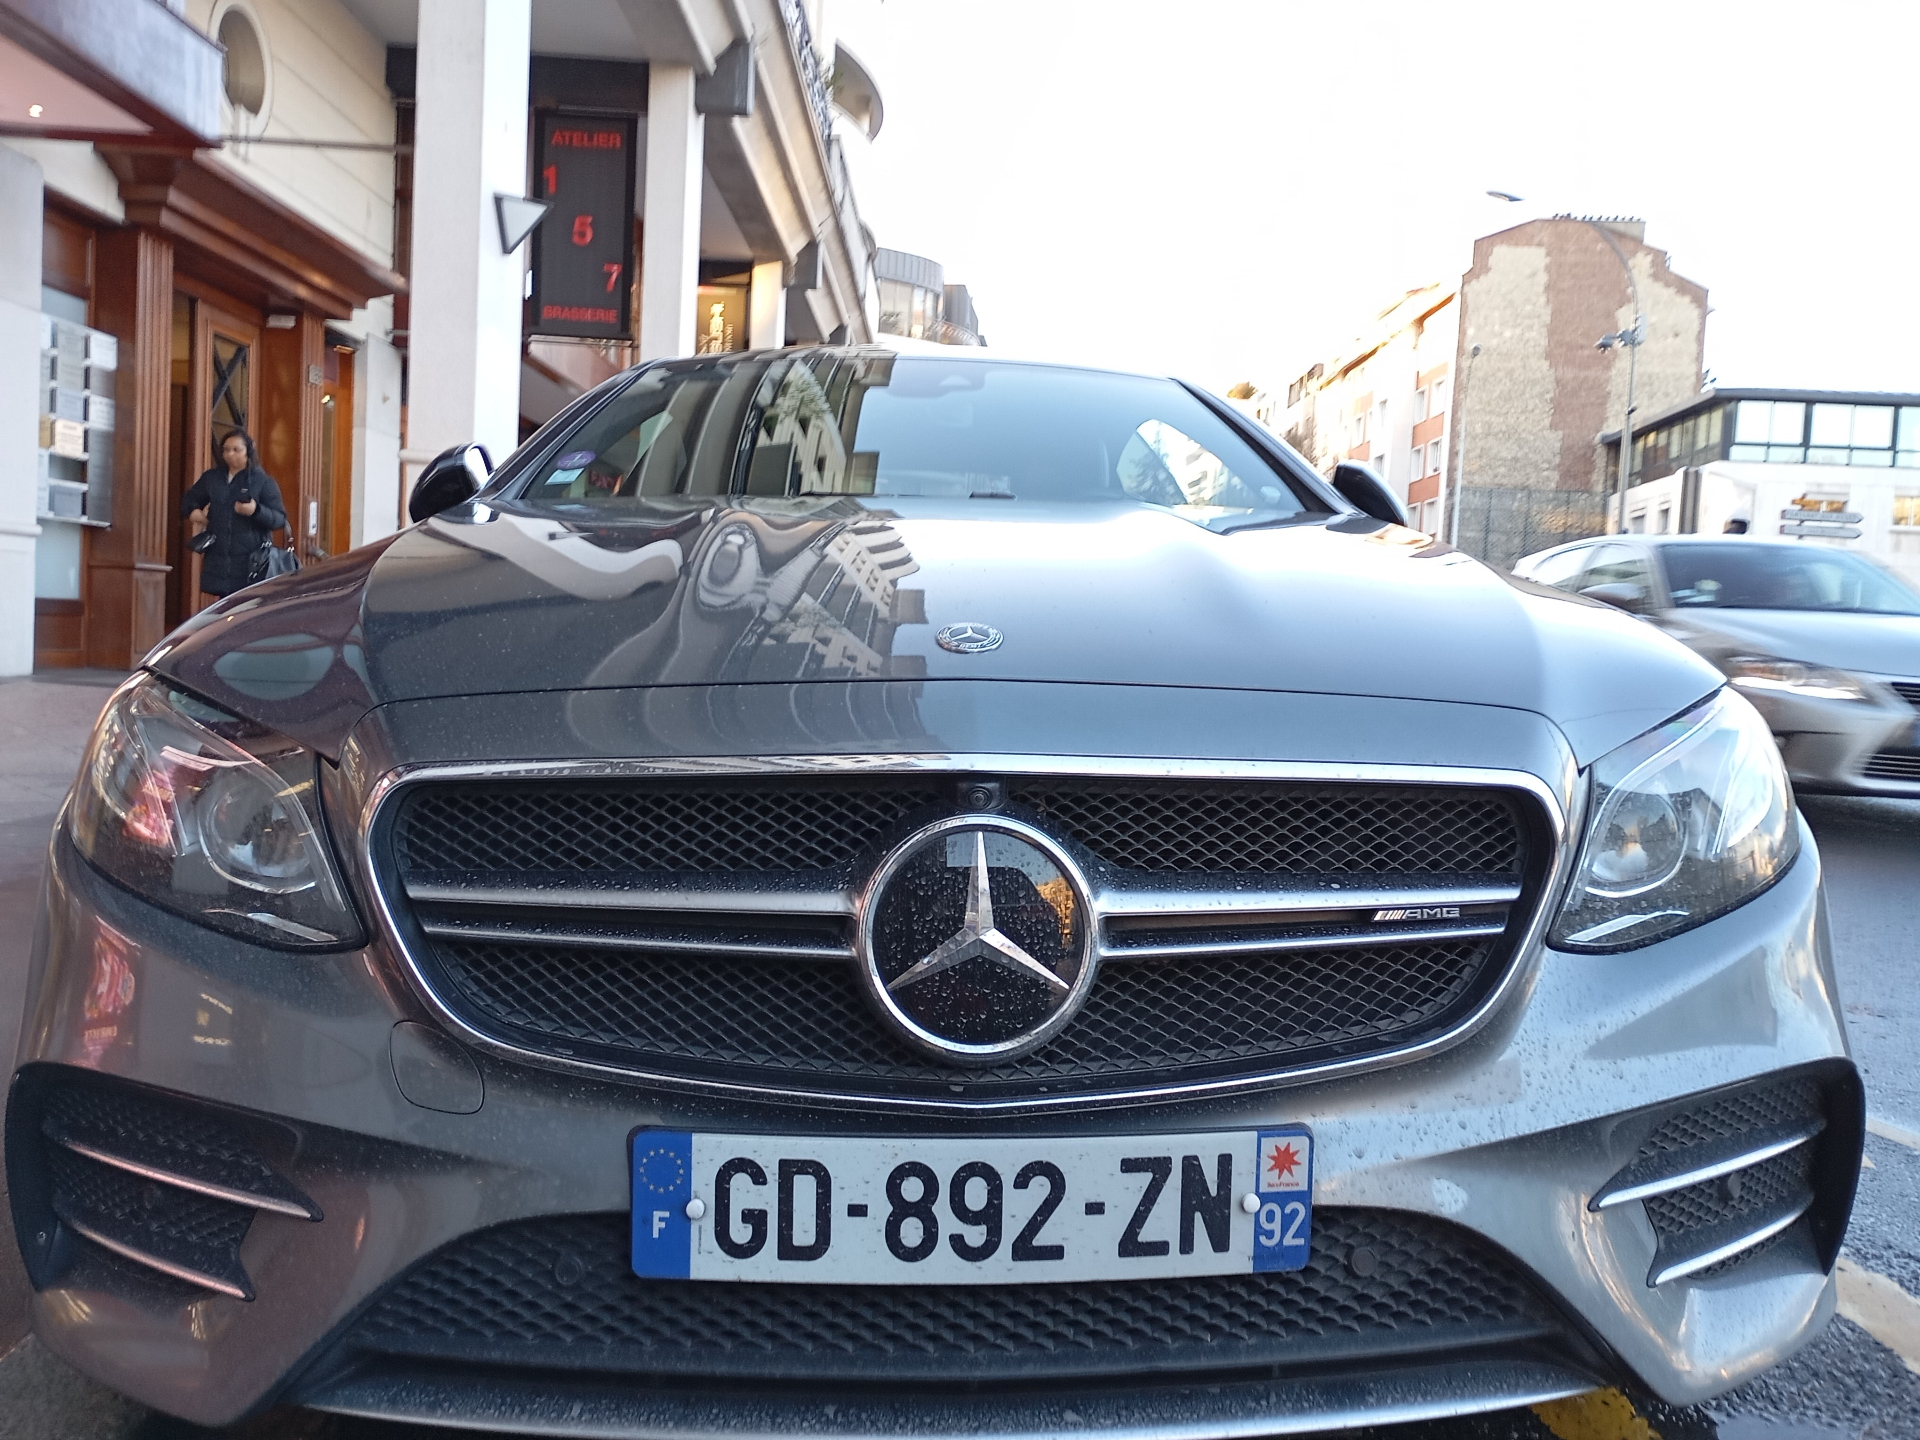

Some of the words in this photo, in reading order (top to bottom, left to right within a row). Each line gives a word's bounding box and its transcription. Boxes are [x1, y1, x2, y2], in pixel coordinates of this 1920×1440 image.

[551, 130, 622, 148] ATELIER
[543, 163, 559, 195] 1
[603, 263, 622, 292] 7
[541, 305, 619, 324] BRASSERIE
[1402, 907, 1460, 919] AMG
[714, 1153, 1234, 1263] GD-892-ZN
[652, 1210, 670, 1239] F
[1258, 1201, 1306, 1247] 92
